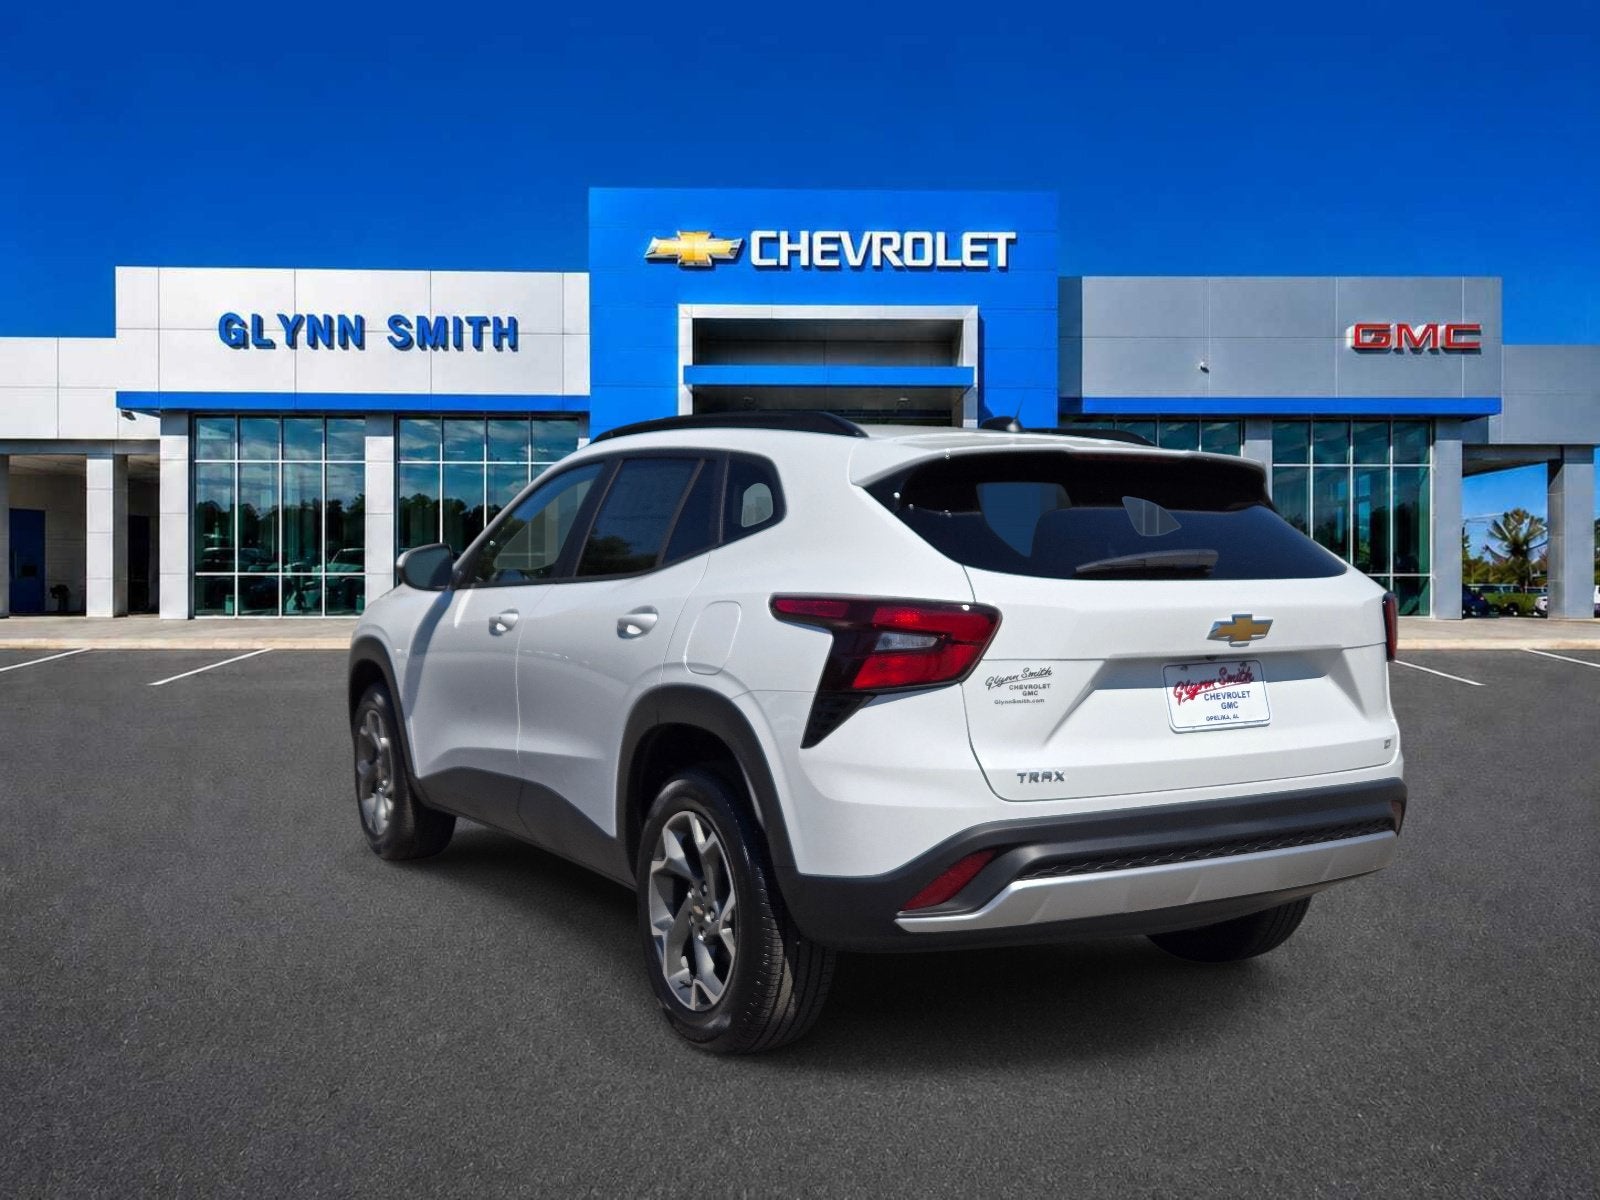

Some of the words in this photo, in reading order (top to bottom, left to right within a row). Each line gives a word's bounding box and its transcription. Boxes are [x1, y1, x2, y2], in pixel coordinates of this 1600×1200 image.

[750, 230, 1017, 269] CHEVROLET
[218, 312, 365, 350] GLYNN
[387, 314, 519, 352] SMITH
[1350, 323, 1482, 352] GMC
[985, 674, 1019, 690] Glynn
[1021, 666, 1053, 679] Smith
[1008, 683, 1052, 691] CHEVROLET
[1173, 679, 1217, 706] Glynn
[1218, 666, 1255, 686] Smith
[994, 698, 1045, 706] GlynnSmith.com
[1203, 690, 1251, 702] CHEVROLET
[1220, 701, 1239, 710] GMC
[1016, 770, 1065, 784] TRAX
